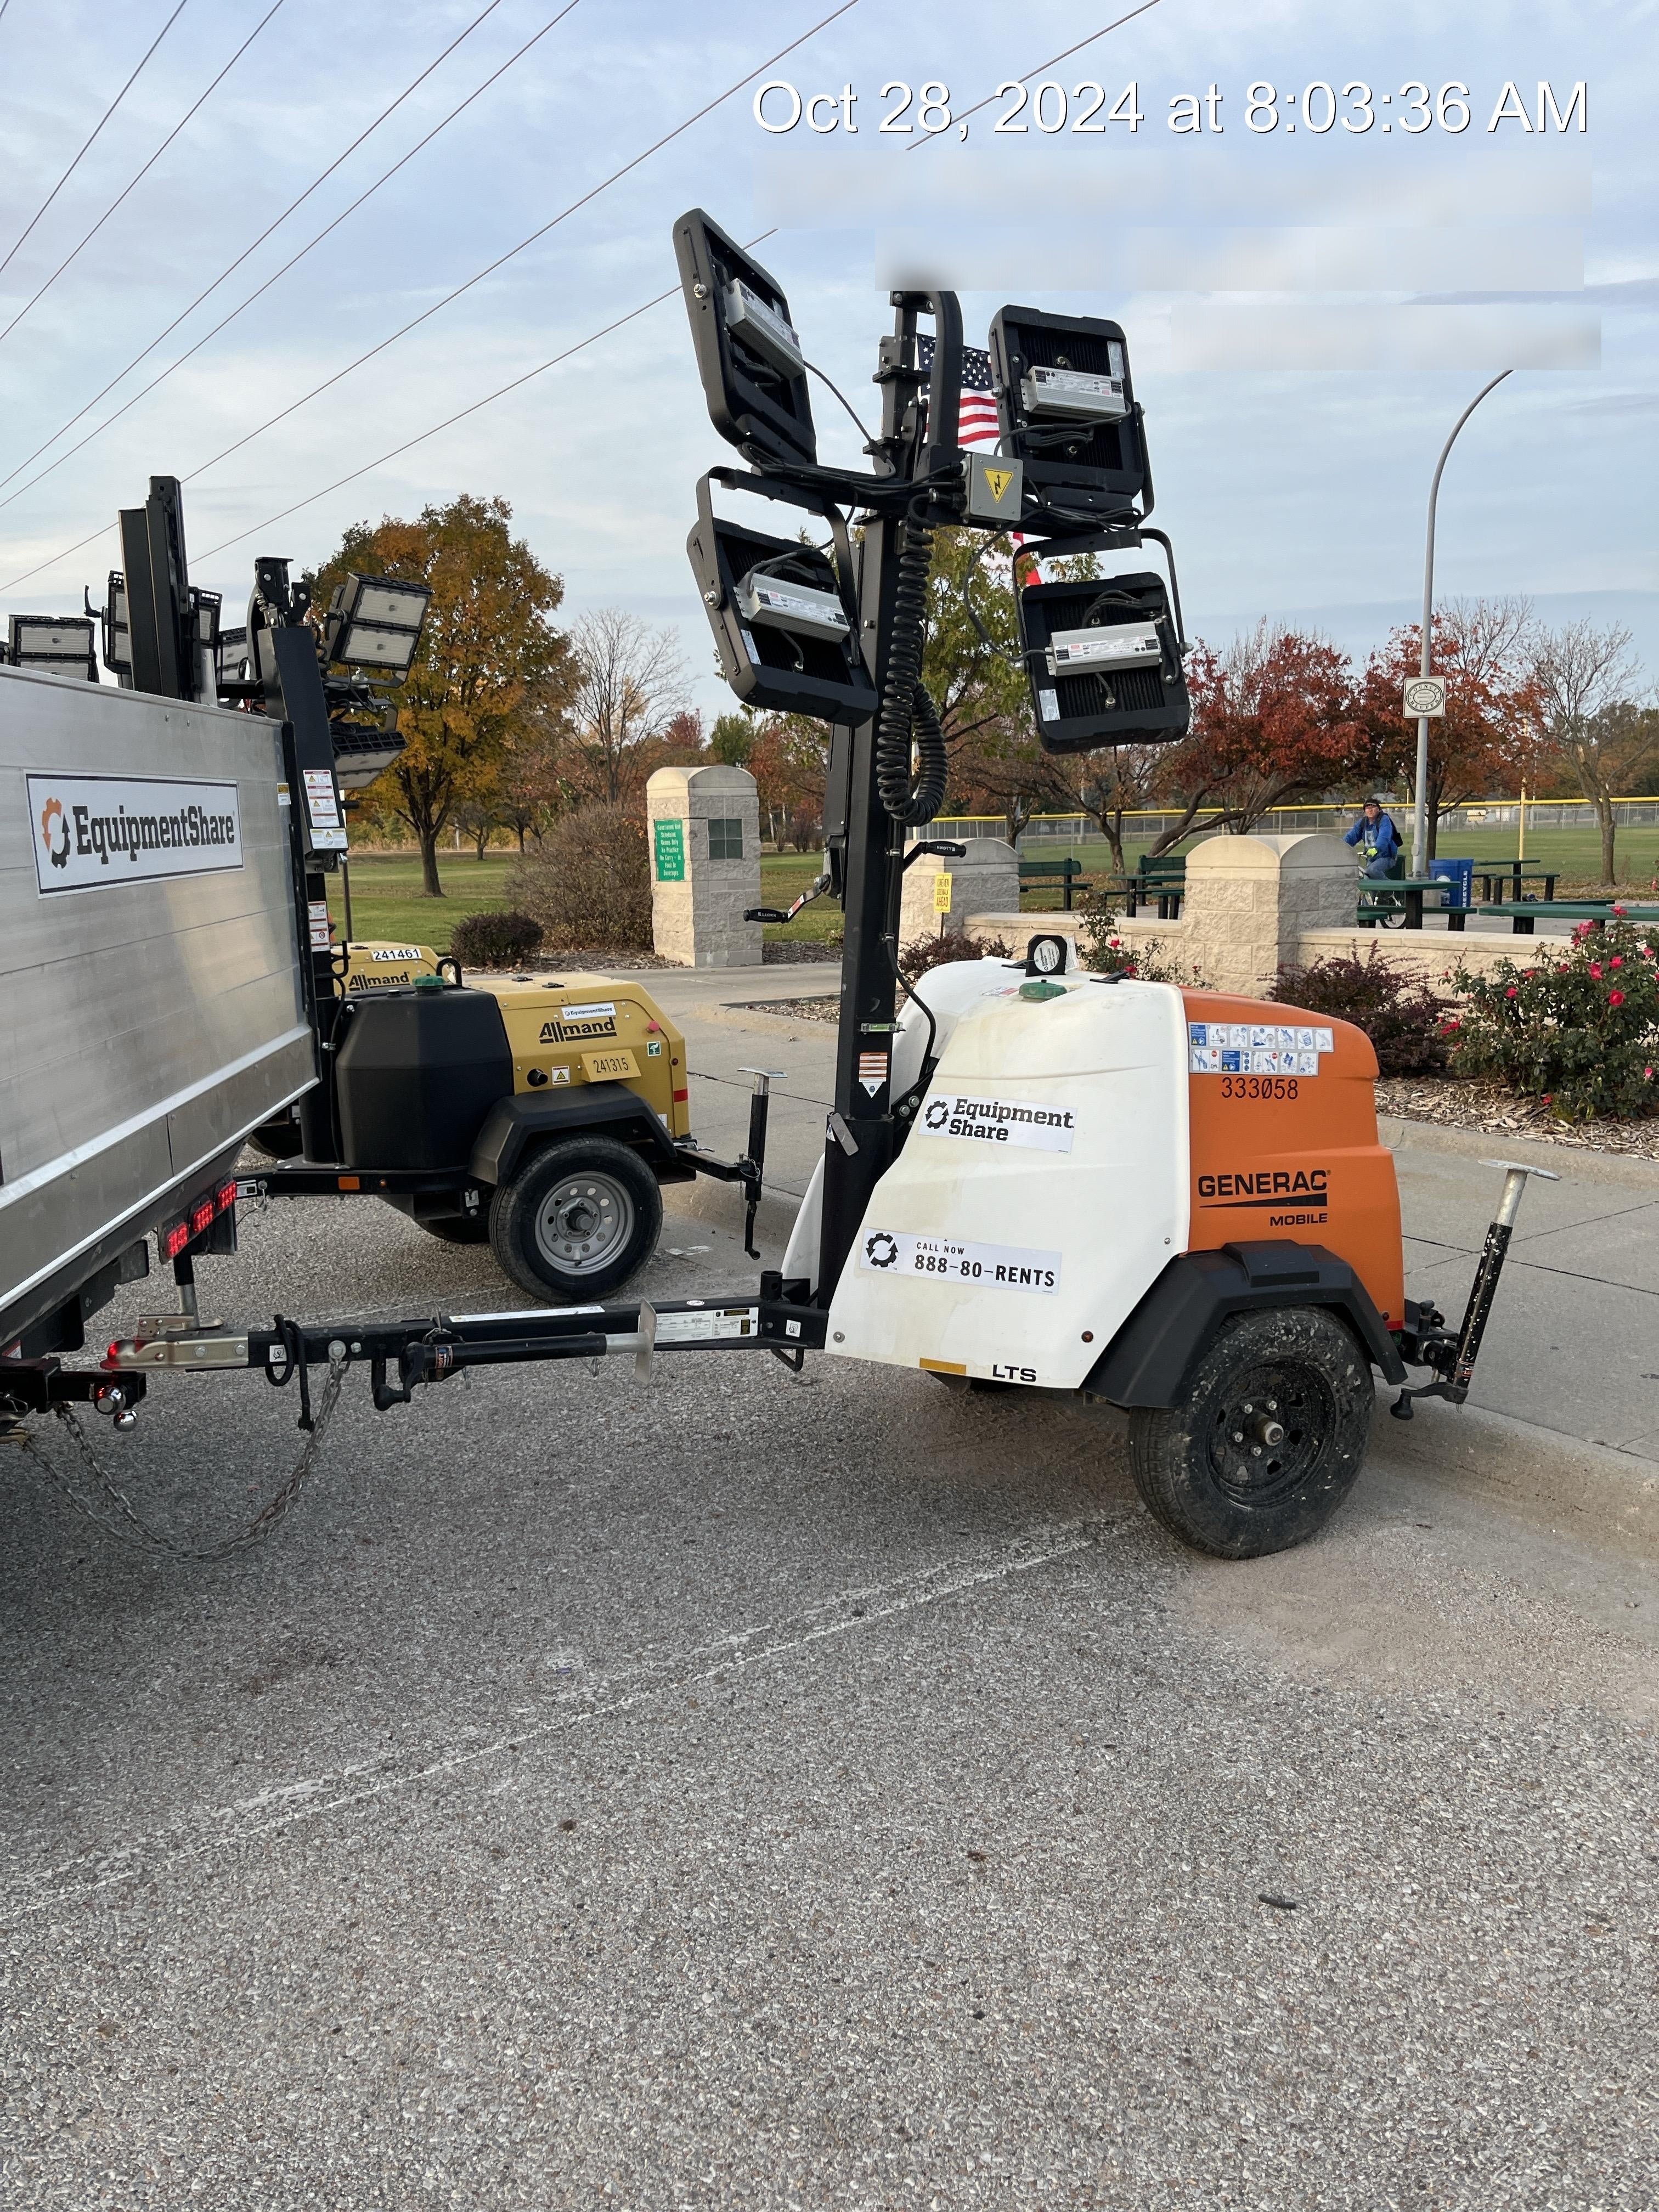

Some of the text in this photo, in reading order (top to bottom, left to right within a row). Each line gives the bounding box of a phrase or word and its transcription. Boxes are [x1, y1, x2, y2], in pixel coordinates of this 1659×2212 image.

[1409, 684, 1440, 697] COUNCIL
[1409, 699, 1439, 710] BLUFFS
[72, 805, 235, 865] EquipmentShare
[373, 949, 420, 960] 241461
[349, 971, 409, 990] Allmand
[570, 1007, 613, 1015] EquipmentShare
[539, 1017, 616, 1042] Allmand
[593, 1057, 629, 1073] 241315
[1221, 1076, 1298, 1100] 333058
[953, 1098, 1074, 1128] Equipment
[949, 1119, 1009, 1141] Share
[1198, 1170, 1327, 1197] GENERAC
[1270, 1213, 1328, 1227] MOBILE
[916, 1242, 965, 1255] CALL NOW
[915, 1254, 1055, 1287] 888-80-RENTS
[992, 1364, 1036, 1383] LTS
